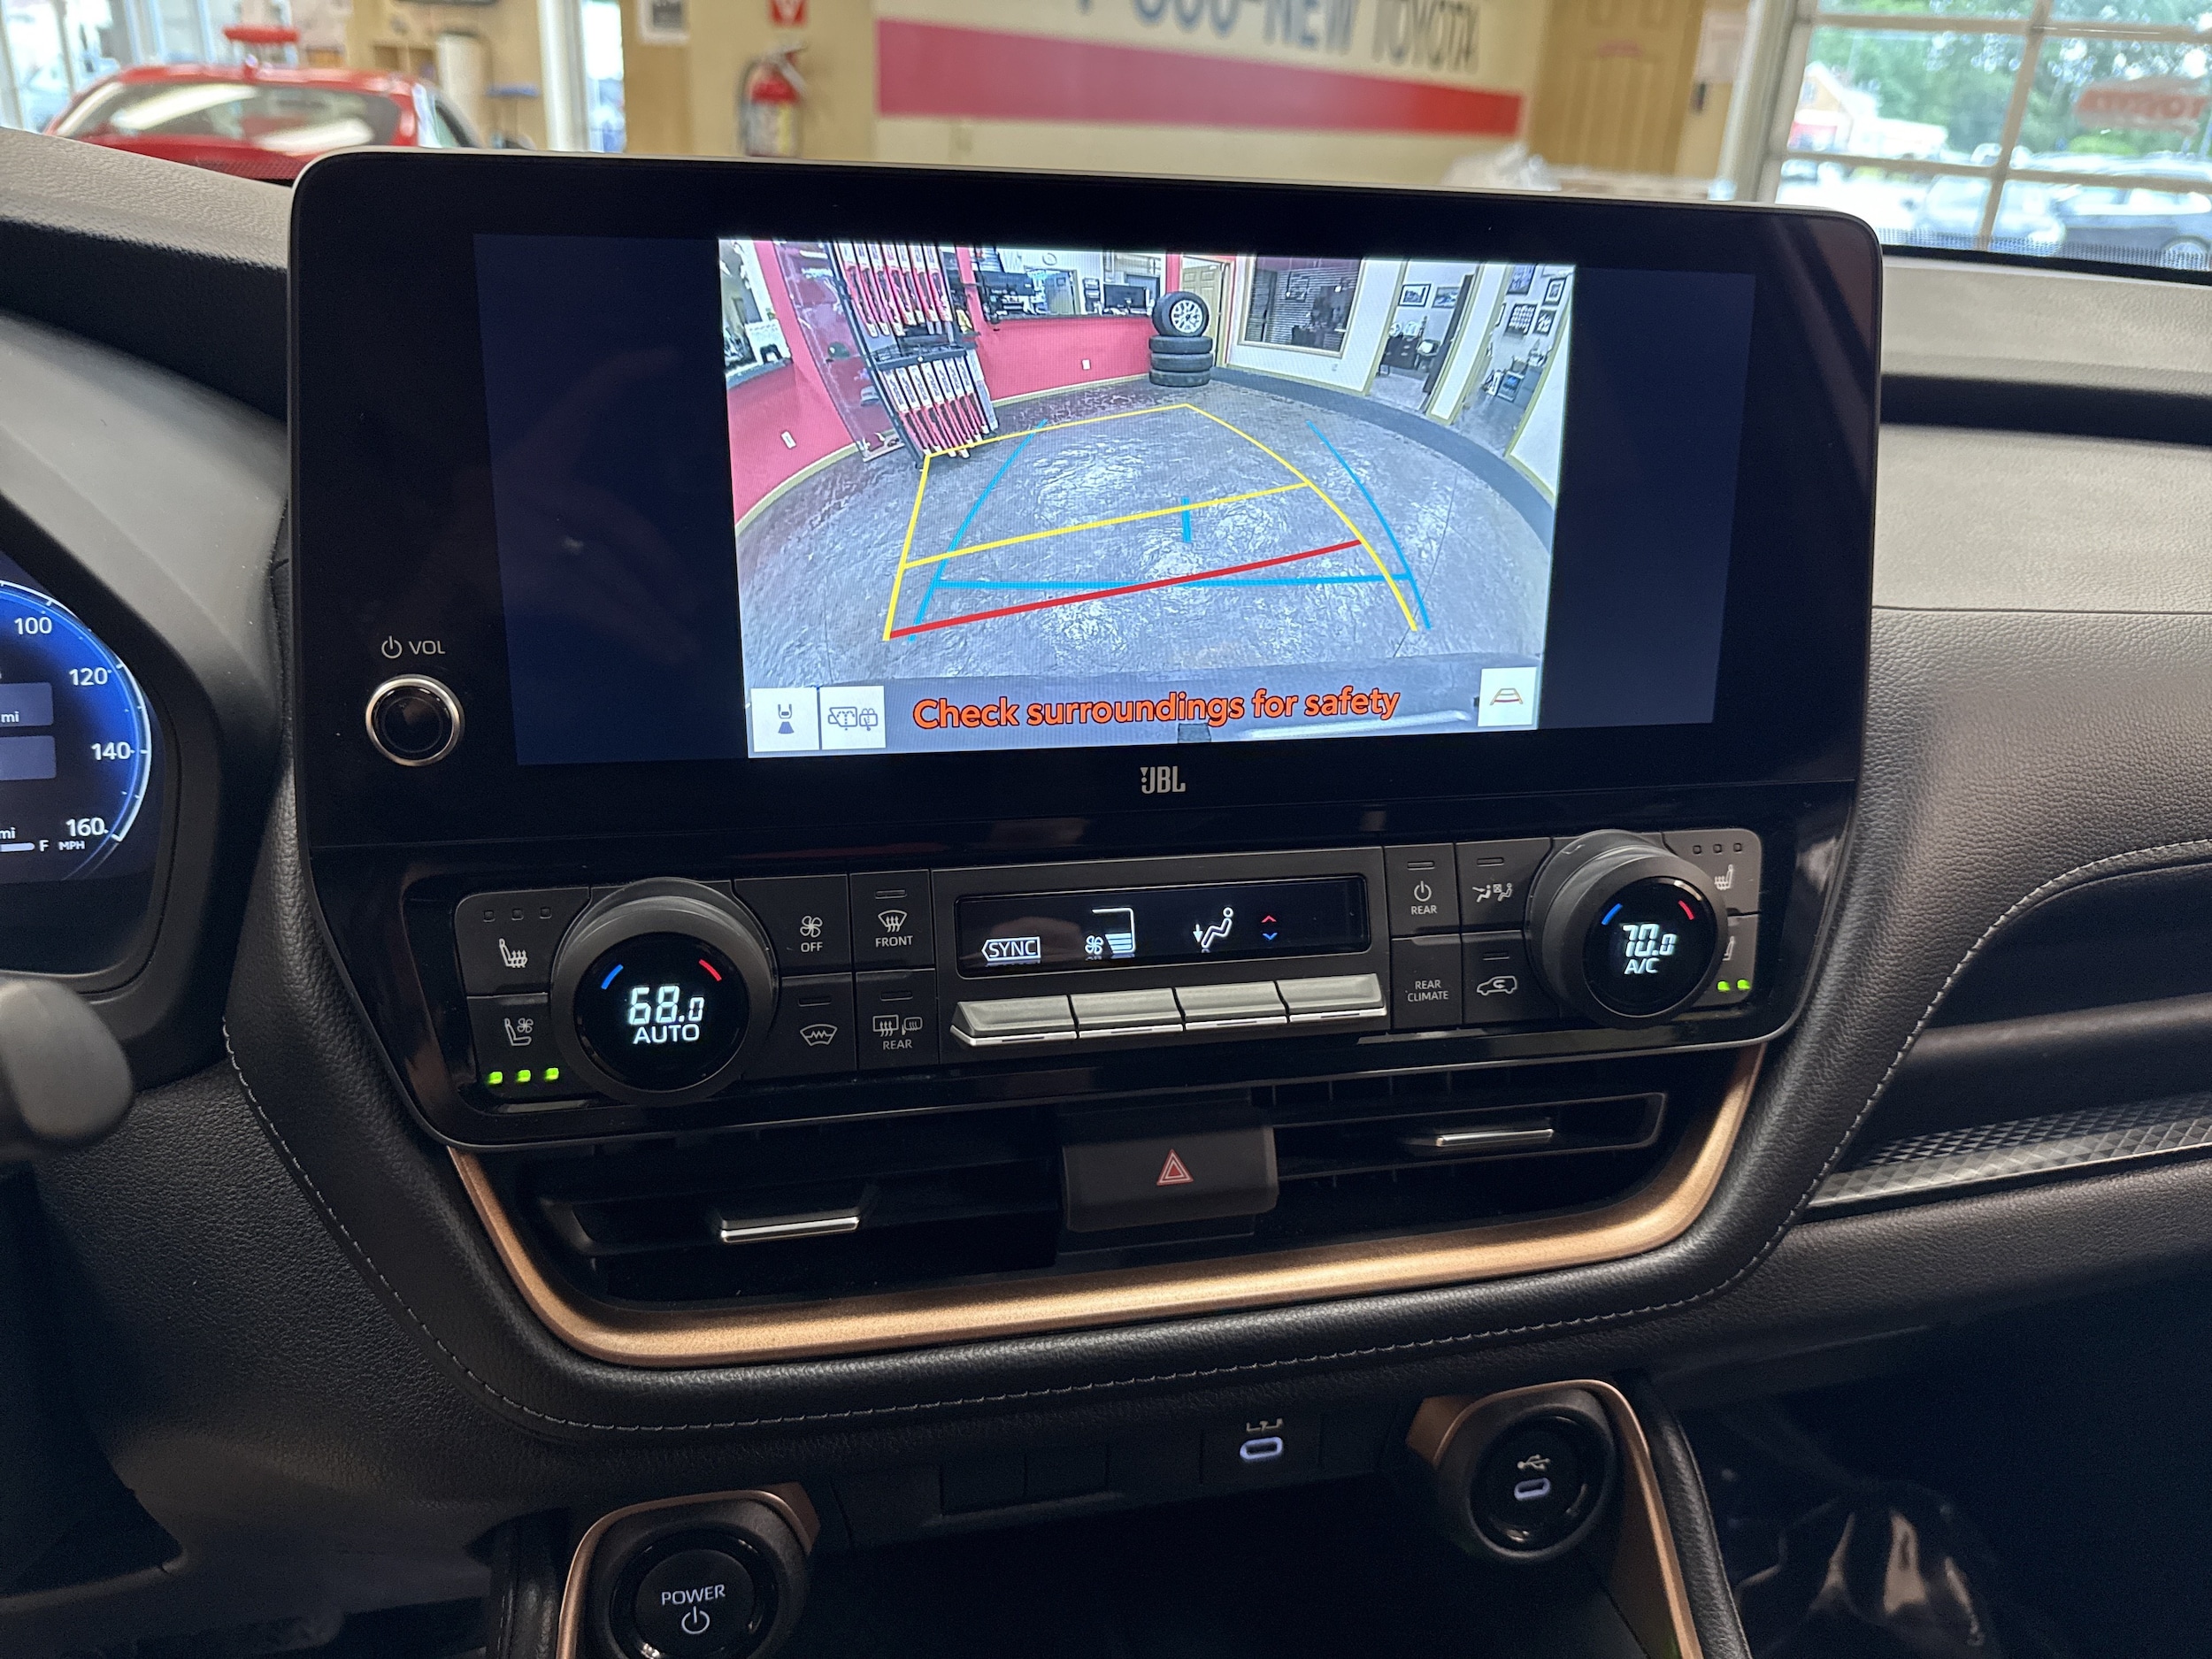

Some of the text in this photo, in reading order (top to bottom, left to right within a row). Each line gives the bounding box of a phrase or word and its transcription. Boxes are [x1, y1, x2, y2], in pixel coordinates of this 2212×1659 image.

[14, 617, 53, 634] 100
[408, 640, 446, 655] VOL
[69, 667, 109, 686] 120
[913, 685, 1401, 729] Check surroundings for safety
[91, 741, 131, 760] 140
[1140, 765, 1187, 795] JBL
[65, 818, 105, 837] 160
[39, 840, 49, 852] F
[58, 841, 86, 851] MPH
[1410, 904, 1438, 915] REAR
[800, 941, 823, 953] OFF
[875, 935, 913, 948] FRONT
[988, 940, 1036, 958] SYNC
[1624, 957, 1660, 975] A/C
[1415, 979, 1442, 990] REAR
[1407, 991, 1449, 1002] CLIMATE
[629, 986, 705, 1025] 68.0
[633, 1024, 700, 1045] AUTO
[882, 1039, 913, 1050] REAR
[661, 1584, 726, 1606] POWER
